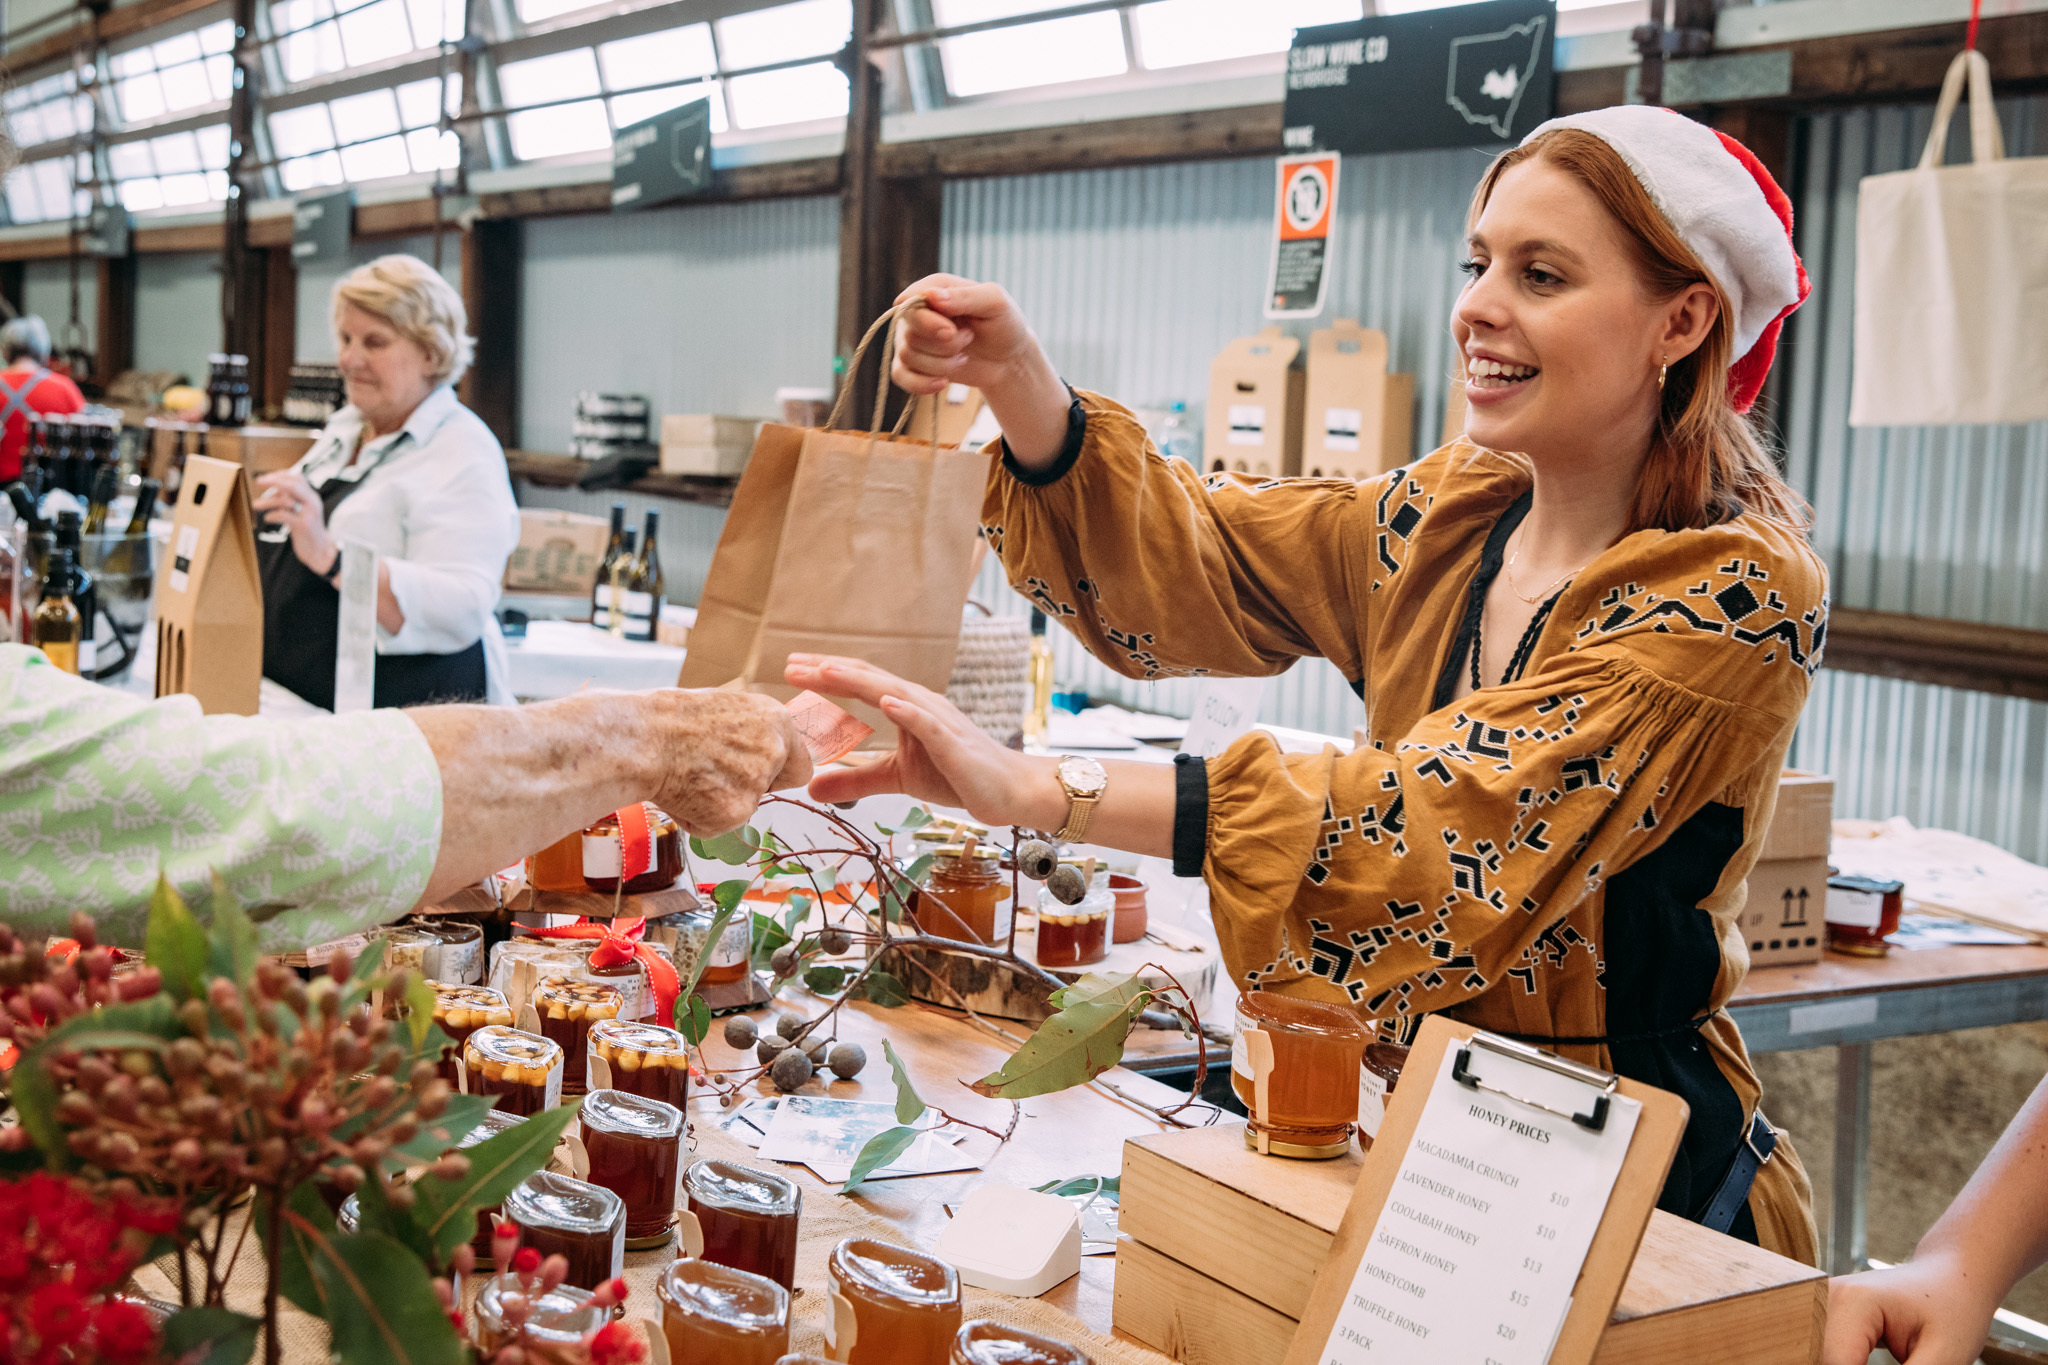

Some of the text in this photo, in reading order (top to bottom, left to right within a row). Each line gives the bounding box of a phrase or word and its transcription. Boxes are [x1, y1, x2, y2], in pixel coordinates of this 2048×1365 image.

[1291, 45, 1326, 70] SLOW
[1328, 38, 1364, 66] WINE
[1468, 1104, 1551, 1144] HONEY PRICES
[1402, 1169, 1556, 1240] LAVENDER HONEY $10
[1415, 1139, 1569, 1208] MACADAMIA CRUNCH $10
[1377, 1231, 1530, 1307] SAFFRON HONEY $15
[1390, 1201, 1542, 1274] COOLABAH HONEY $13
[1352, 1294, 1430, 1339] TRUFFLE HONEY
[1364, 1263, 1516, 1341] HONEYCOMB $20
[1339, 1326, 1373, 1350] 3 PACK
